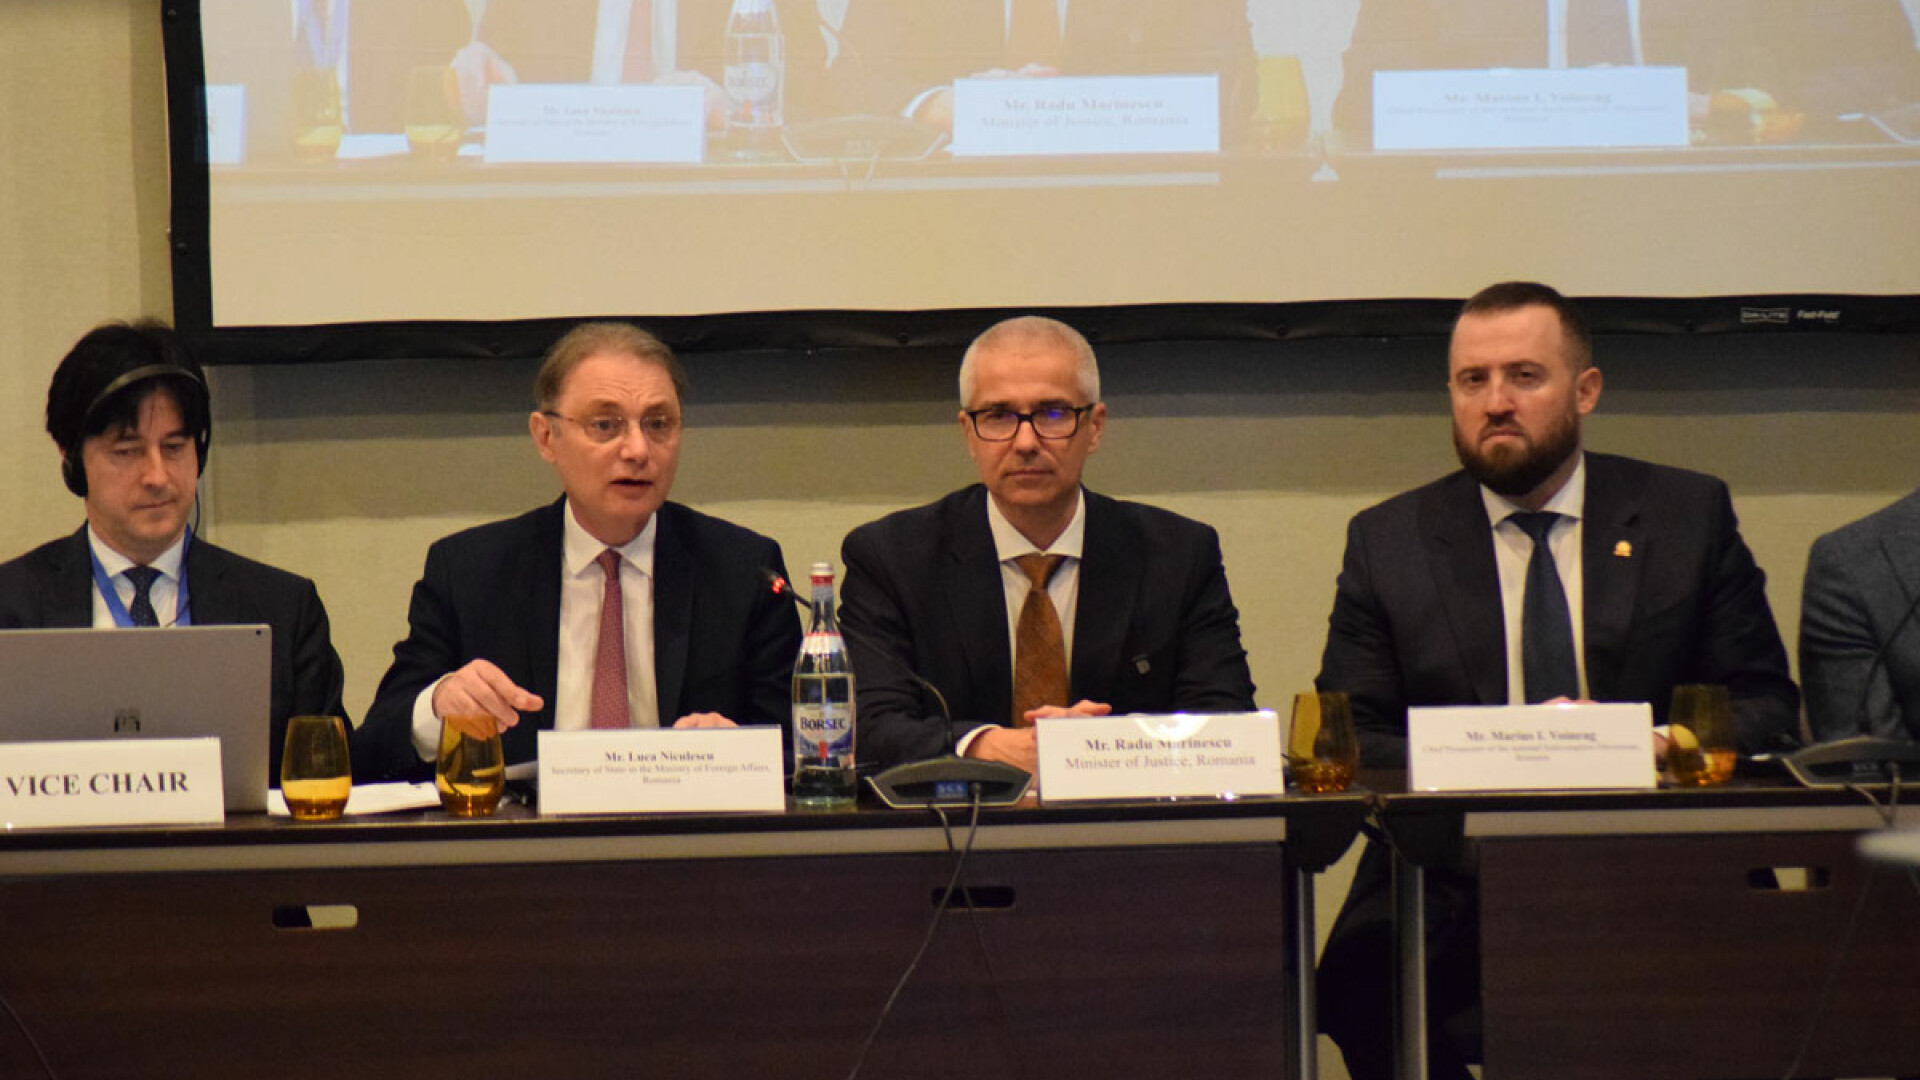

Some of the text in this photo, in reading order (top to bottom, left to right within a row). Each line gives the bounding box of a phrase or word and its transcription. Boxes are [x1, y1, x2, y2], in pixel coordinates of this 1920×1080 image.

[800, 717, 846, 730] BORSEC
[1085, 739, 1111, 751] Mr.
[1115, 738, 1153, 750] Radu
[604, 750, 715, 763] Mr. Luca Niculescu
[1065, 757, 1121, 770] Minister
[1125, 756, 1140, 769] of
[1197, 754, 1256, 767] Romania
[6, 771, 189, 796] VICE CHAIR
